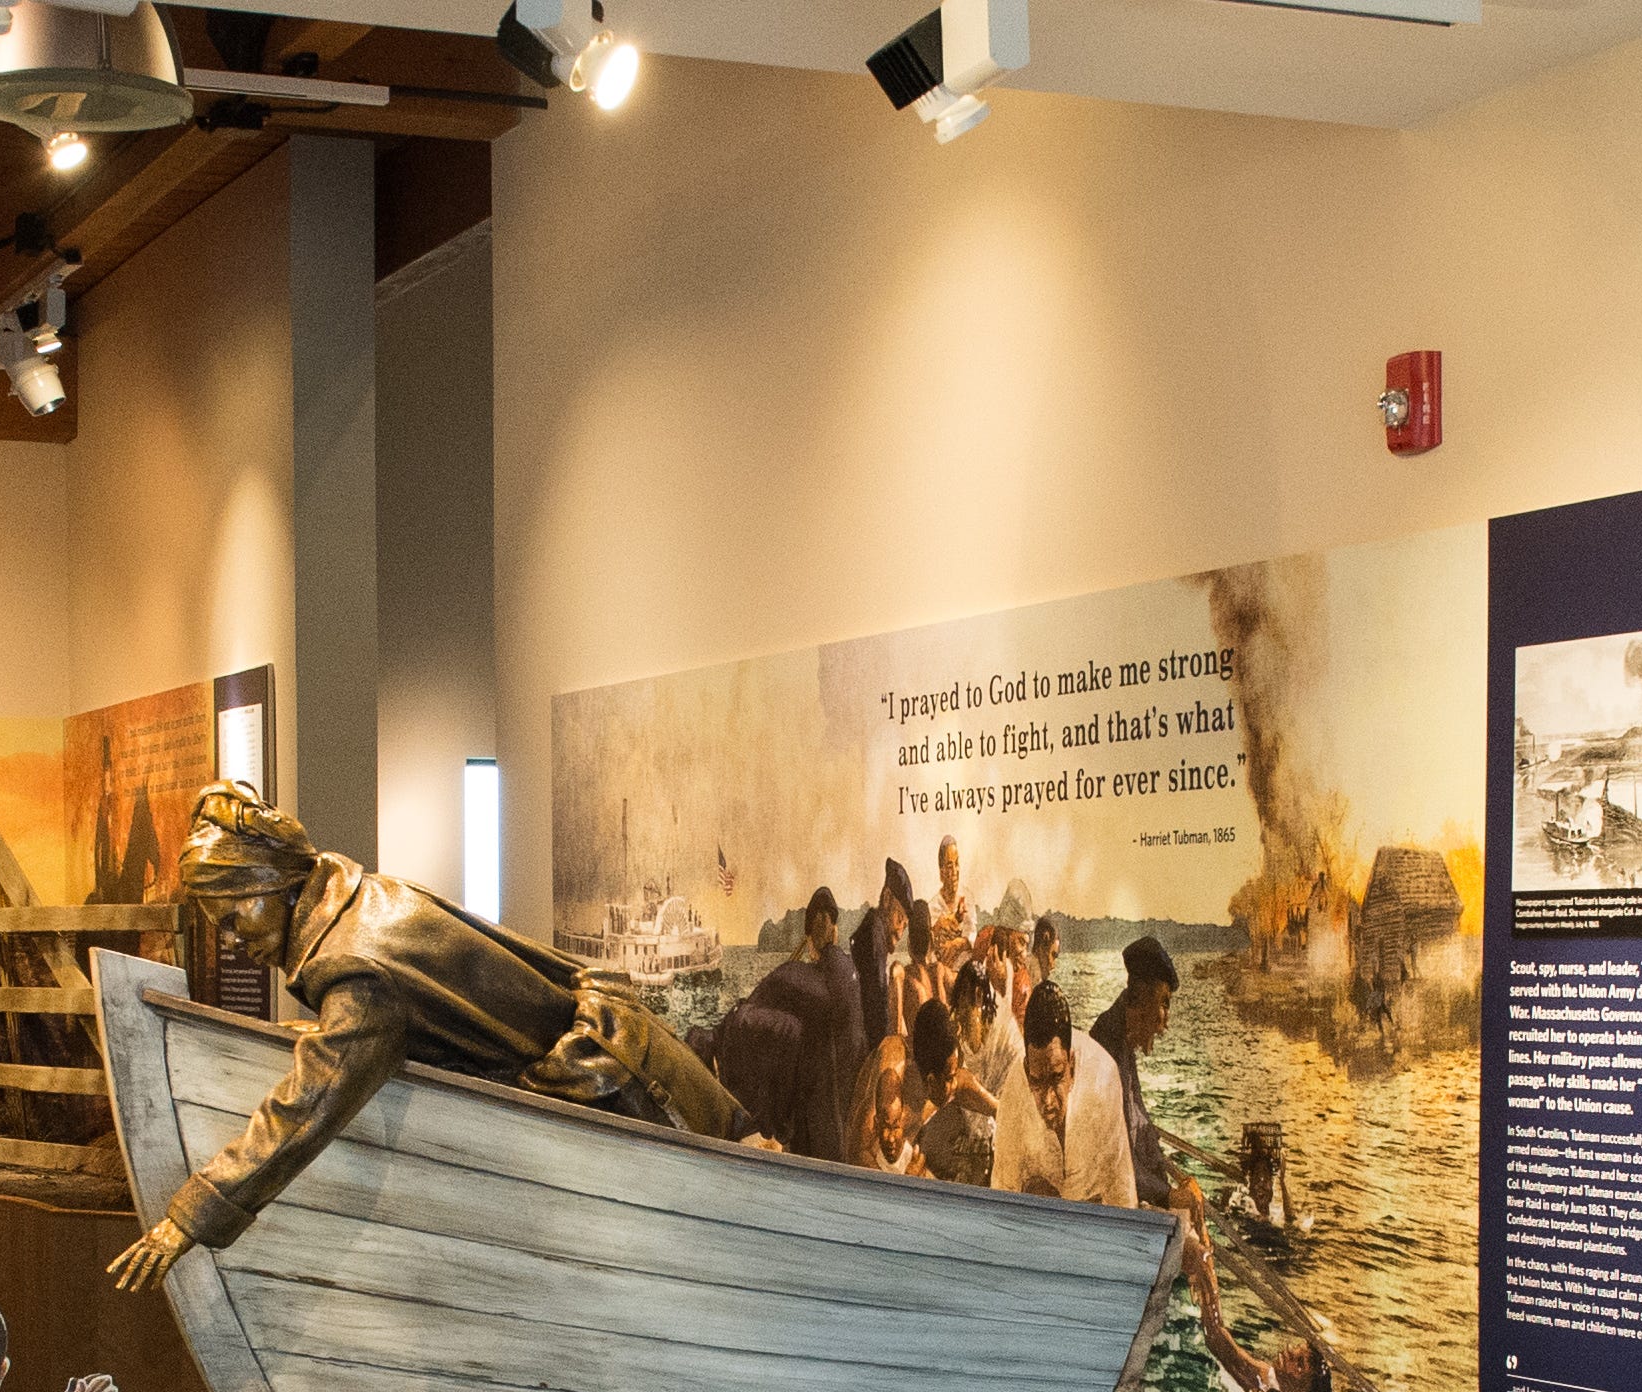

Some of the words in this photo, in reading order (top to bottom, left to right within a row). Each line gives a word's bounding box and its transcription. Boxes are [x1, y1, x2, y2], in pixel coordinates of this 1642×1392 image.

[1422, 382, 1431, 424] FIRE
[900, 682, 960, 724] prayed
[965, 683, 982, 708] to
[989, 672, 1027, 705] God
[1033, 672, 1051, 699] to
[1057, 662, 1112, 695] make
[1119, 661, 1151, 686] me
[1158, 643, 1235, 681] strong
[898, 736, 930, 766] and
[937, 731, 973, 761] able
[980, 731, 996, 757] to
[1003, 722, 1055, 758] fight,
[1062, 714, 1100, 747] and
[1107, 706, 1168, 743] that's
[1176, 699, 1235, 734] what
[898, 787, 929, 814] I've
[935, 783, 996, 814] always
[1002, 771, 1069, 812] prayed
[1075, 769, 1106, 799] for
[1113, 770, 1158, 796] ever
[1140, 832, 1171, 846] Harriet
[1174, 830, 1210, 844] Tubman,
[1213, 827, 1235, 842] 1865
[1510, 961, 1537, 976] Scout,
[1539, 964, 1557, 977] spy,
[1559, 964, 1587, 977] nurse,
[1588, 961, 1607, 975] and
[1608, 961, 1639, 977] leader,
[1510, 983, 1540, 997] served
[1541, 983, 1561, 997] with
[1562, 983, 1577, 998] the
[1579, 984, 1607, 998] Union
[1608, 984, 1635, 1002] Army
[1510, 1005, 1530, 1019] War.
[1532, 1006, 1600, 1021] Massachusetts
[1509, 1028, 1549, 1042] recruited
[1550, 1028, 1566, 1042] her
[1568, 1030, 1577, 1043] to
[1579, 1031, 1615, 1046] operate
[1509, 1049, 1532, 1063] lines.
[1533, 1051, 1551, 1064] Her
[1552, 1052, 1587, 1069] military
[1589, 1056, 1610, 1069] pass
[1508, 1075, 1547, 1089] passage.
[1548, 1074, 1565, 1088] Her
[1567, 1074, 1591, 1089] skills
[1592, 1076, 1618, 1091] made
[1620, 1077, 1635, 1091] her
[1546, 1097, 1556, 1110] to
[1557, 1096, 1573, 1111] the
[1574, 1098, 1601, 1113] Union
[1603, 1103, 1633, 1115] cause.
